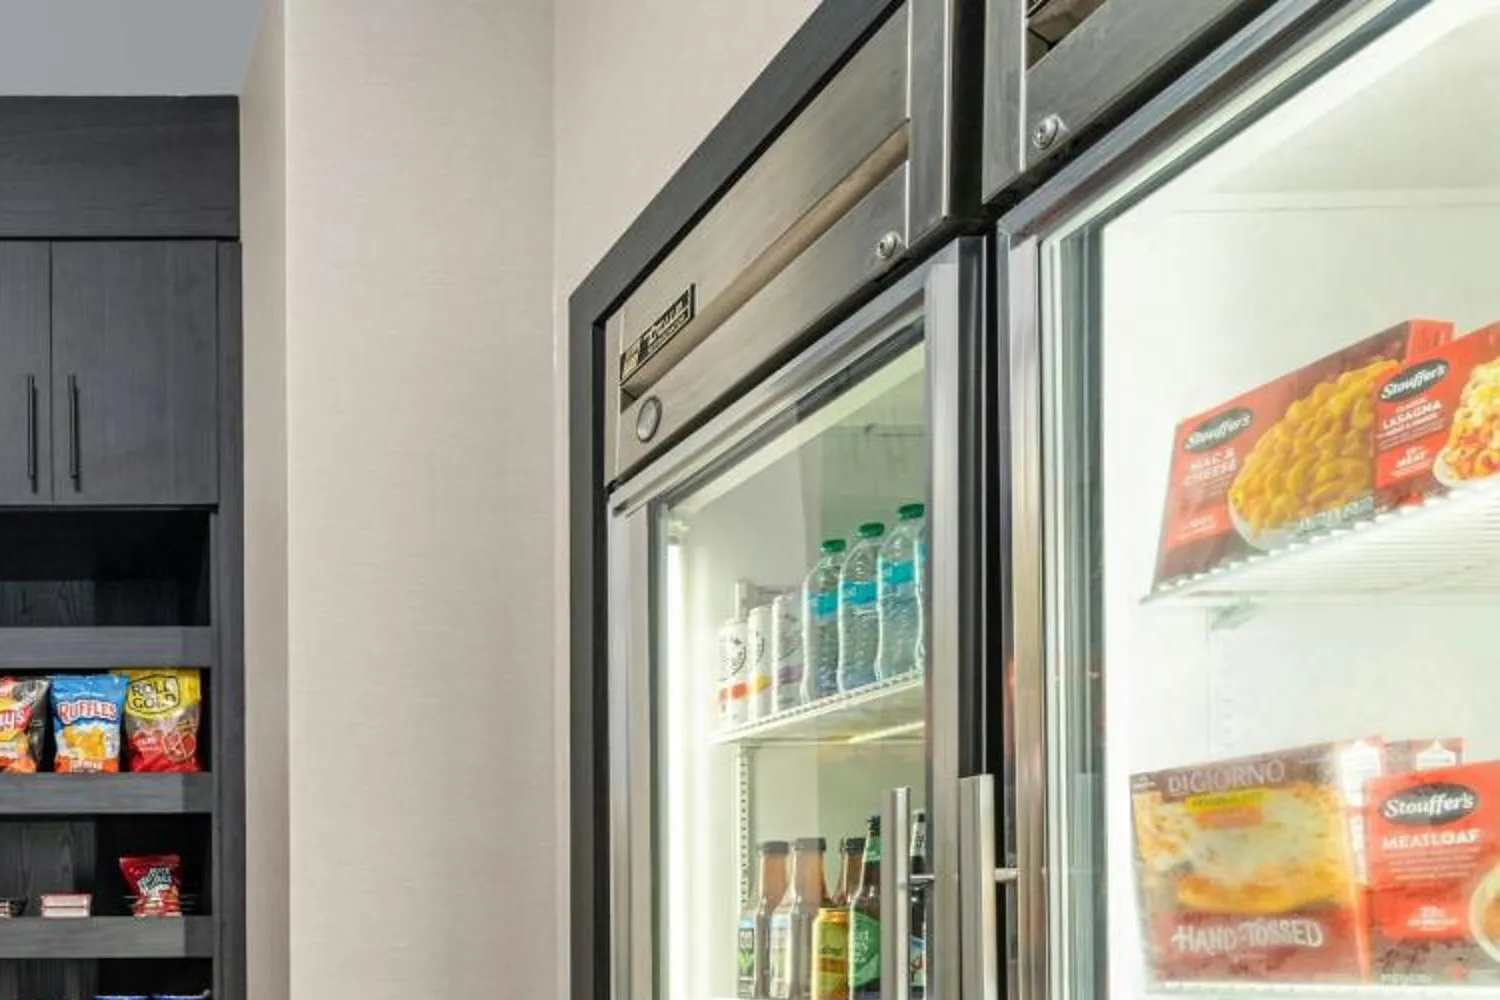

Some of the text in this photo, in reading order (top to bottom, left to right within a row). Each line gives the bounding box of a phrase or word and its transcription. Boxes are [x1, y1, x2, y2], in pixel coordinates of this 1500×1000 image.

[58, 701, 118, 724] RUFFLES
[1168, 757, 1285, 794] DIGIORNO
[1382, 792, 1475, 819] Stouffer's
[1382, 830, 1482, 851] MEATLOAF
